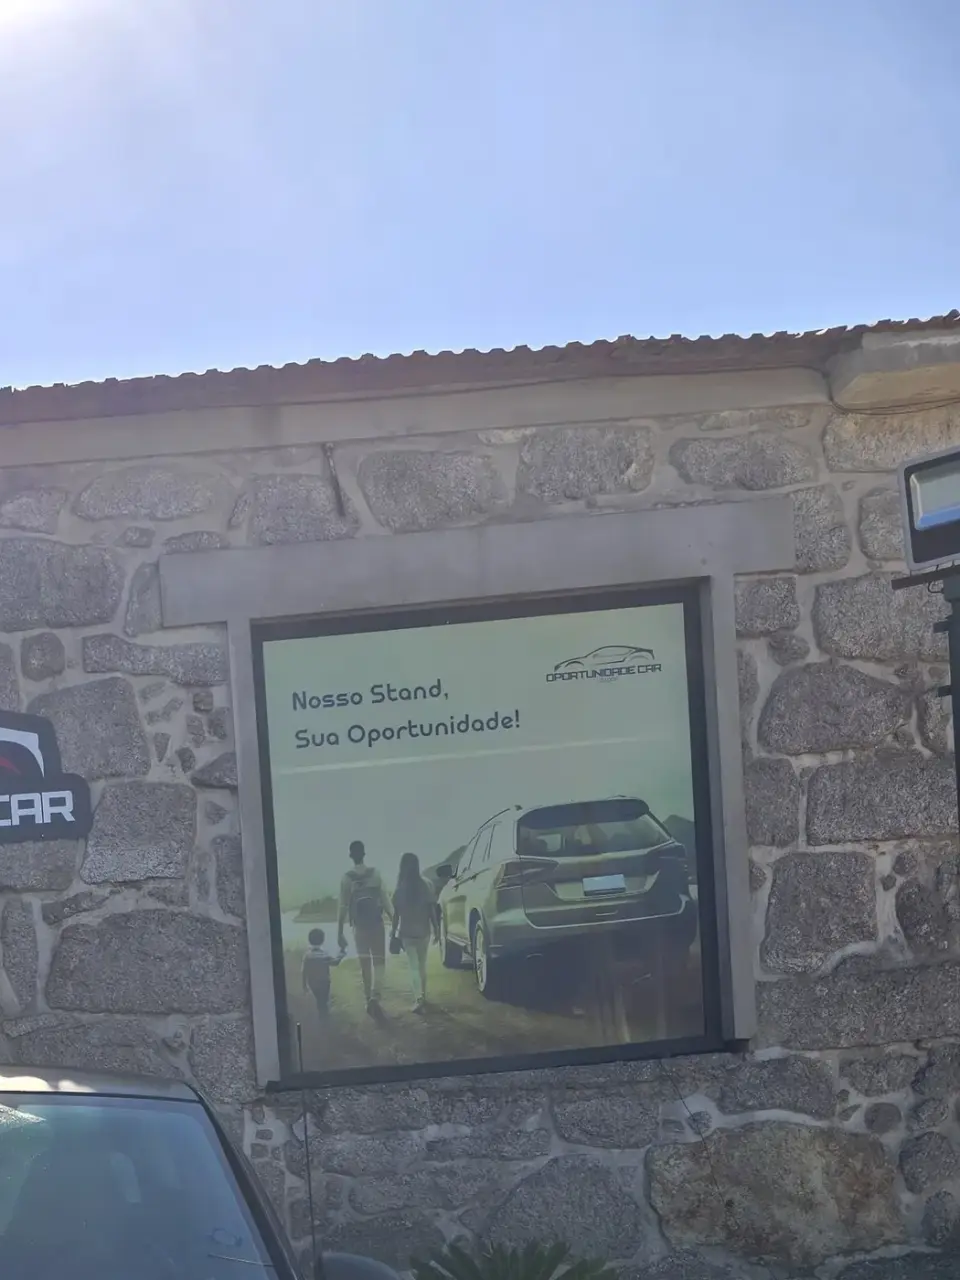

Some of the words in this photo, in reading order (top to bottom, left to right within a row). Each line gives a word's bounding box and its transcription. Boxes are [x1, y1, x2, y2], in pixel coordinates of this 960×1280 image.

[546, 666, 636, 682] OPORTUNIDADE
[638, 664, 661, 674] CAR
[292, 690, 363, 711] Nosso
[371, 679, 449, 704] Stand,
[295, 728, 340, 749] Sua
[347, 710, 520, 747] Oportunidade!
